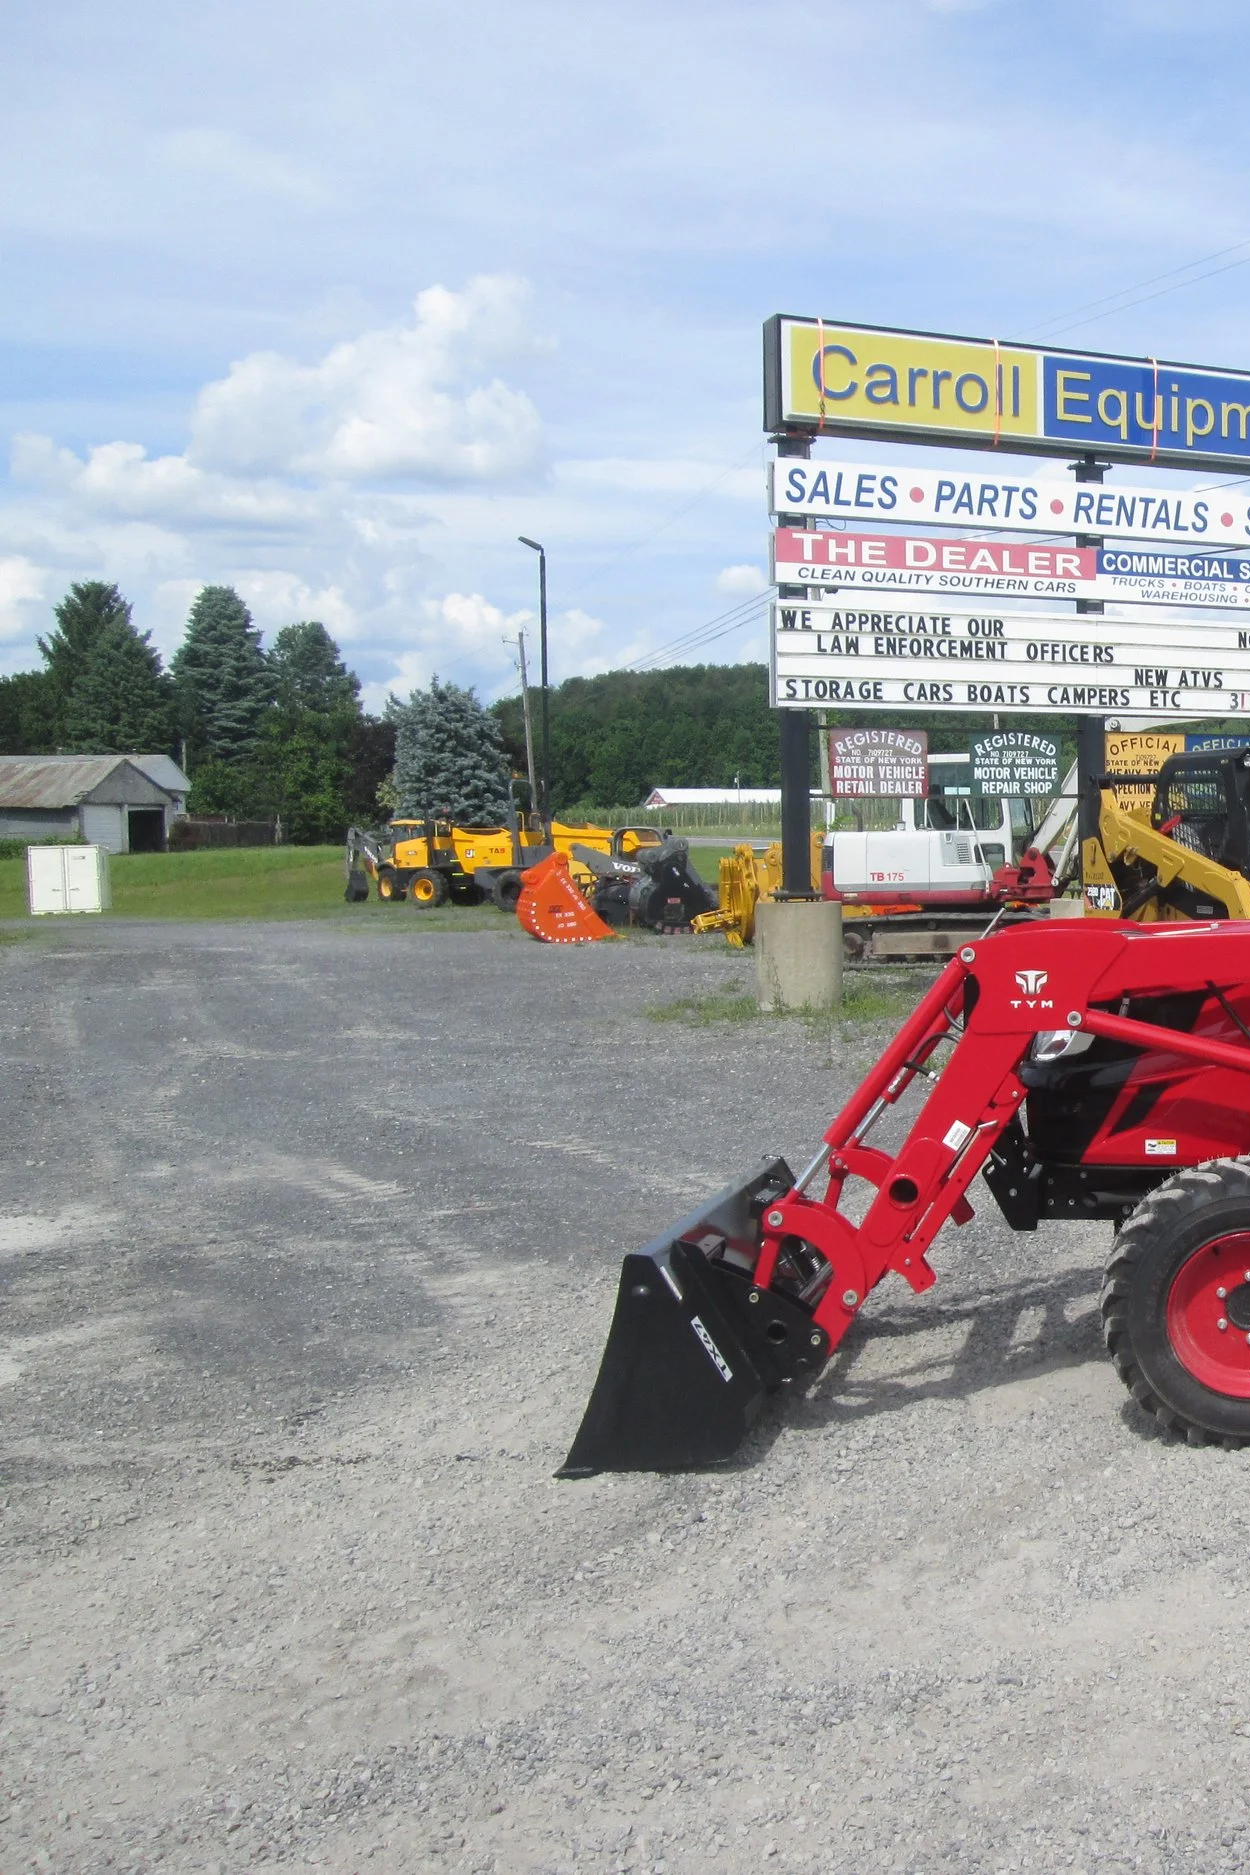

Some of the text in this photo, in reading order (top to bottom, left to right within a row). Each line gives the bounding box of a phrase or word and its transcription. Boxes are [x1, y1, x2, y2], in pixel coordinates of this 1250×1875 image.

[812, 344, 1020, 417] Carroll
[785, 468, 899, 509] SALES
[934, 480, 1038, 520] PARTS
[1073, 491, 1209, 533] RENTALS
[792, 532, 1083, 577] THE DEALER
[1102, 553, 1234, 579] COMMERCIAL
[798, 567, 1077, 594] CLEAN QUALITY SOUTHERN CARS
[1111, 576, 1166, 589] TRUCKS
[1183, 581, 1227, 593] BOATS
[1140, 589, 1239, 605] WAREHOUSING
[781, 609, 1005, 638] WE APPRECIATE OUR
[816, 633, 1115, 664] LAW ENFORCEMENT OFFICERS
[1134, 668, 1224, 689] NEW ATVS
[785, 678, 1182, 708] STORAGE CARS BOATS CAMPERS ETC
[835, 730, 922, 755] REGISTERED
[974, 732, 1057, 757] REGISTERED
[1109, 736, 1178, 756] OFFICIAL
[835, 756, 861, 764] STATE
[864, 756, 876, 764] OF
[898, 757, 923, 765] YORK
[974, 757, 1000, 765] STATE
[1105, 759, 1129, 767] STATE
[1131, 759, 1141, 767] OF
[833, 765, 925, 779] MOTOR VEHICLE
[973, 766, 1058, 780] MOTOR VEHICLE
[836, 780, 923, 794] RETAIL DEALER
[981, 781, 1053, 794] REPAIR SHOP
[869, 872, 905, 882] TB 175
[1100, 887, 1116, 909] CAT
[1010, 1000, 1053, 1009] TYM
